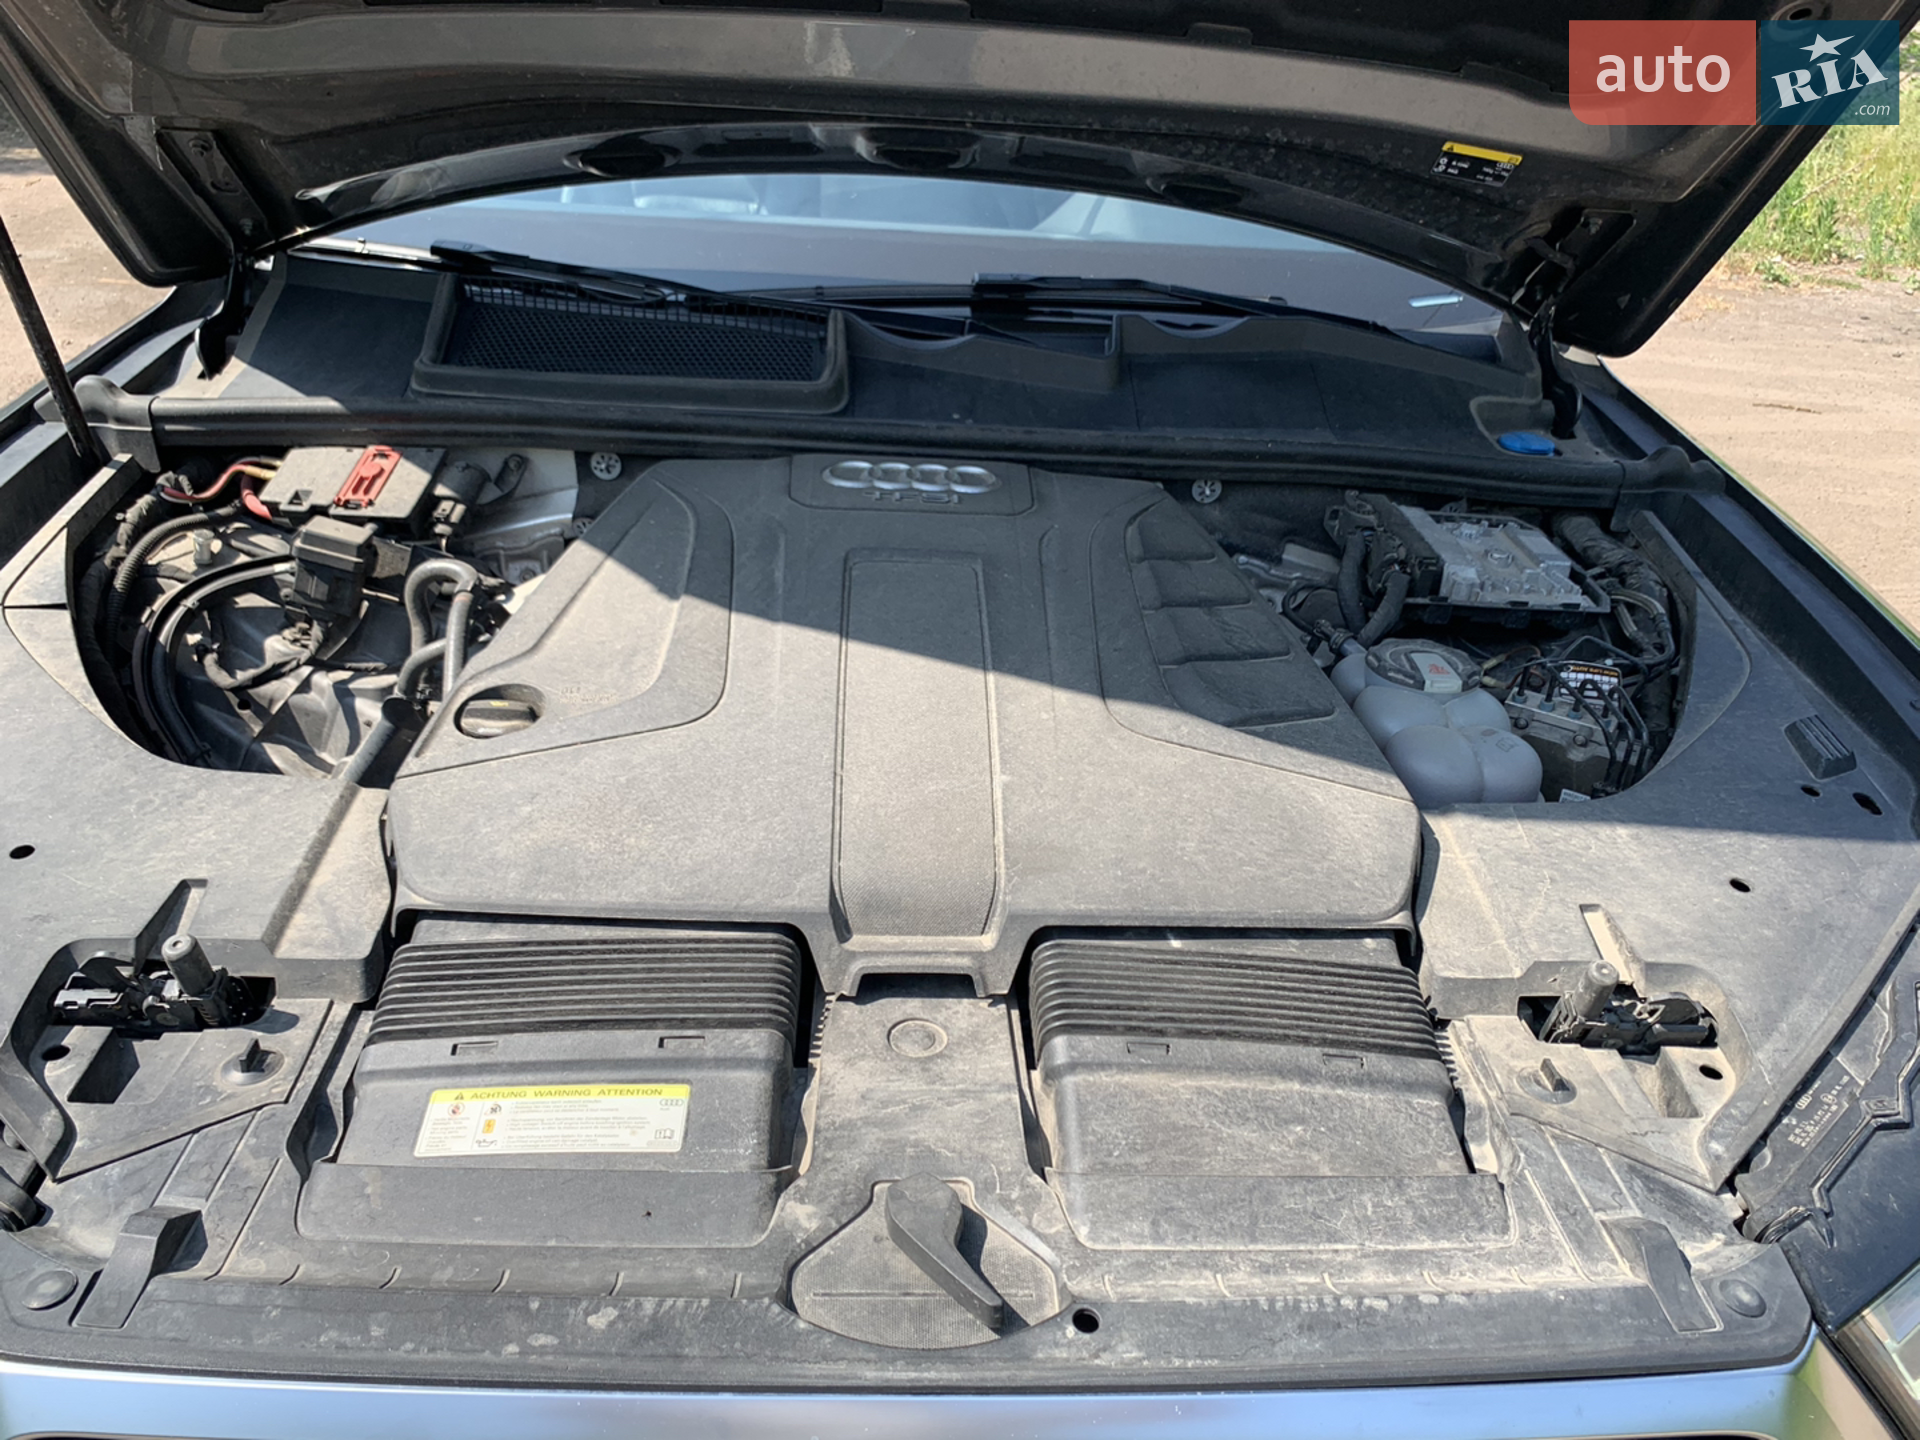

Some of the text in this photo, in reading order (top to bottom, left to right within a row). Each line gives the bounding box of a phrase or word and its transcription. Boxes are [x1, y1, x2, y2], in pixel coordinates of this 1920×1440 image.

[863, 490, 962, 504] TFSI
[470, 1087, 664, 1100] ACHTUNG WARNING ATTENTION
